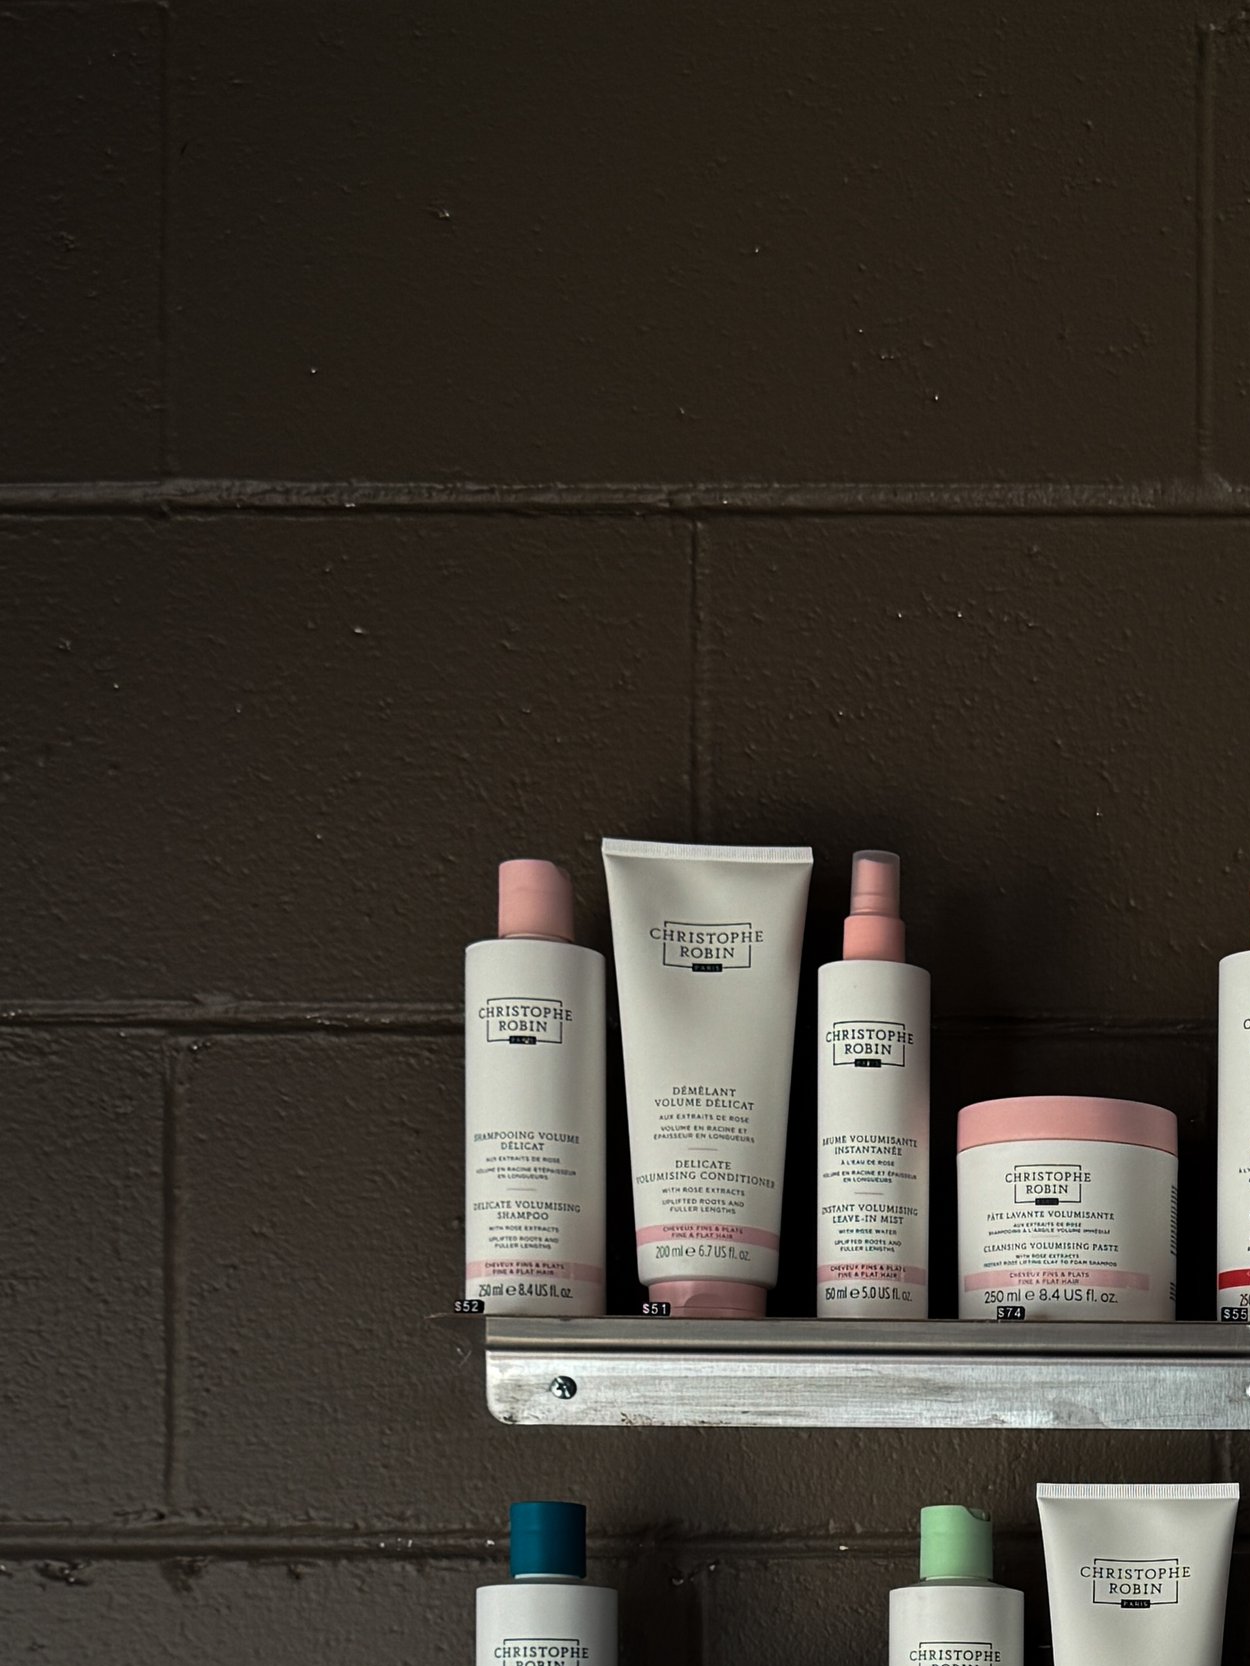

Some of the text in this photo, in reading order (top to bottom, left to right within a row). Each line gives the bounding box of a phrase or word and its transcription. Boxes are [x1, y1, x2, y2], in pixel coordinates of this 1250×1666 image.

[650, 928, 763, 944] CHRISTOPHE
[680, 946, 734, 958] ROBIN
[478, 1005, 573, 1022] CHRISTOPHE
[498, 1020, 548, 1032] ROBIN
[826, 1029, 914, 1044] CHRISTOPHE
[845, 1044, 892, 1055] ROBIN
[655, 1098, 754, 1110] VOLUME DÉLICAT
[675, 1160, 731, 1169] DELICATE
[700, 1173, 775, 1189] CONDITIONER
[1005, 1172, 1091, 1182] CHRISTOPHE
[1026, 1184, 1068, 1194] ROBIN
[983, 1242, 1119, 1253] CLEANSING VOLUMISING PASTE
[985, 1289, 1118, 1304] 250 ml 8.4 US fl. oz.
[1080, 1566, 1191, 1579] CHRISTOPHE
[1109, 1583, 1162, 1594] ROBIN
[494, 1646, 589, 1659] CHRISTOPHE
[910, 1650, 1000, 1662] CHRISTOPHE
